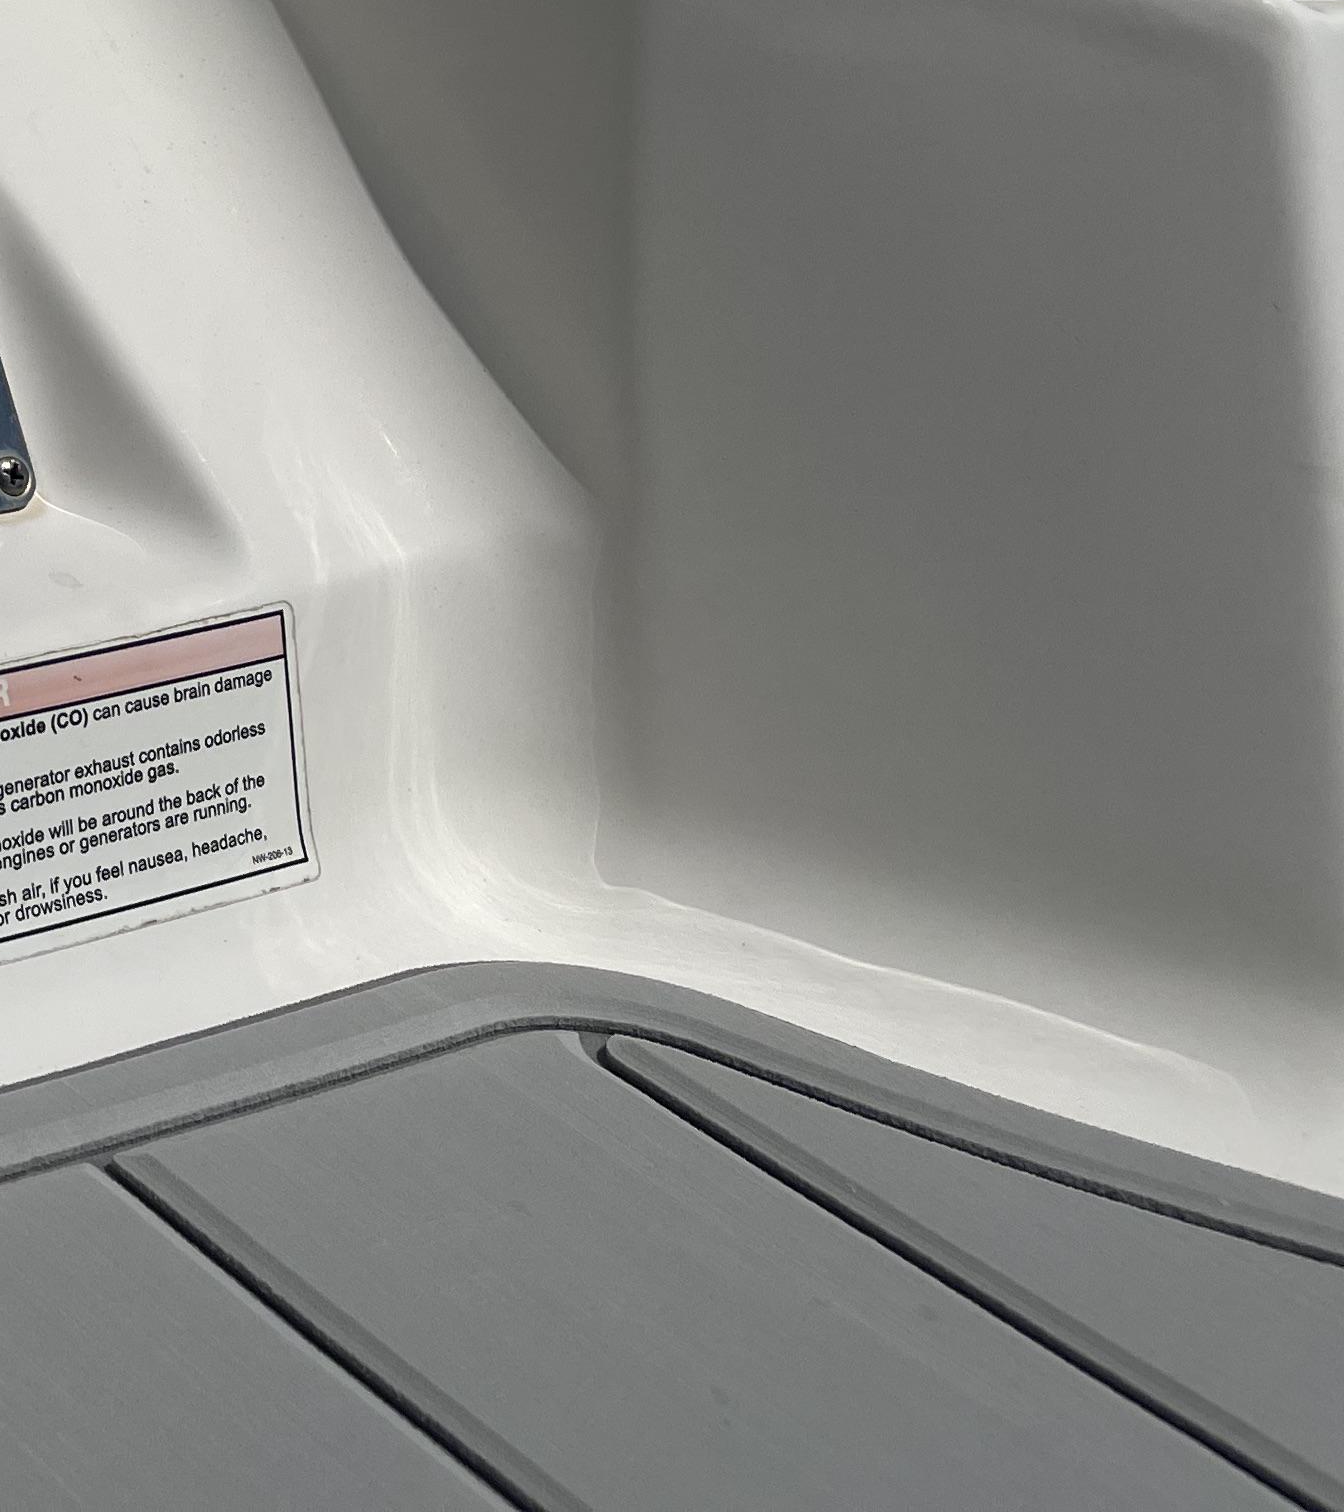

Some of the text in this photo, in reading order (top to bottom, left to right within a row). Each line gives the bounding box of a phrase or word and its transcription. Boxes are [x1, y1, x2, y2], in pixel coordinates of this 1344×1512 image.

[50, 707, 89, 735] (CO)
[92, 704, 121, 721] can
[124, 693, 170, 714] cause
[173, 681, 211, 703] brain
[214, 669, 273, 694] damage
[74, 751, 136, 779] exhaust
[138, 738, 201, 764] contains
[204, 722, 266, 749] odorless
[10, 788, 65, 813] carbon
[69, 767, 144, 799] monoxide
[147, 762, 180, 784] gas.
[48, 818, 74, 840] will
[77, 816, 98, 833] be
[102, 798, 155, 827] around
[158, 795, 182, 812] the
[186, 783, 222, 806] back
[224, 777, 239, 796] of
[242, 774, 265, 792] the
[59, 839, 76, 855] or
[79, 819, 161, 854] generators
[164, 812, 189, 829] are
[193, 797, 252, 822] running.
[20, 882, 46, 906] air,
[49, 876, 60, 894] if
[62, 872, 92, 895] you
[95, 860, 125, 883] feel
[128, 849, 188, 875] nausea,
[191, 828, 267, 858] headache,
[15, 888, 108, 922] drowsiness.
